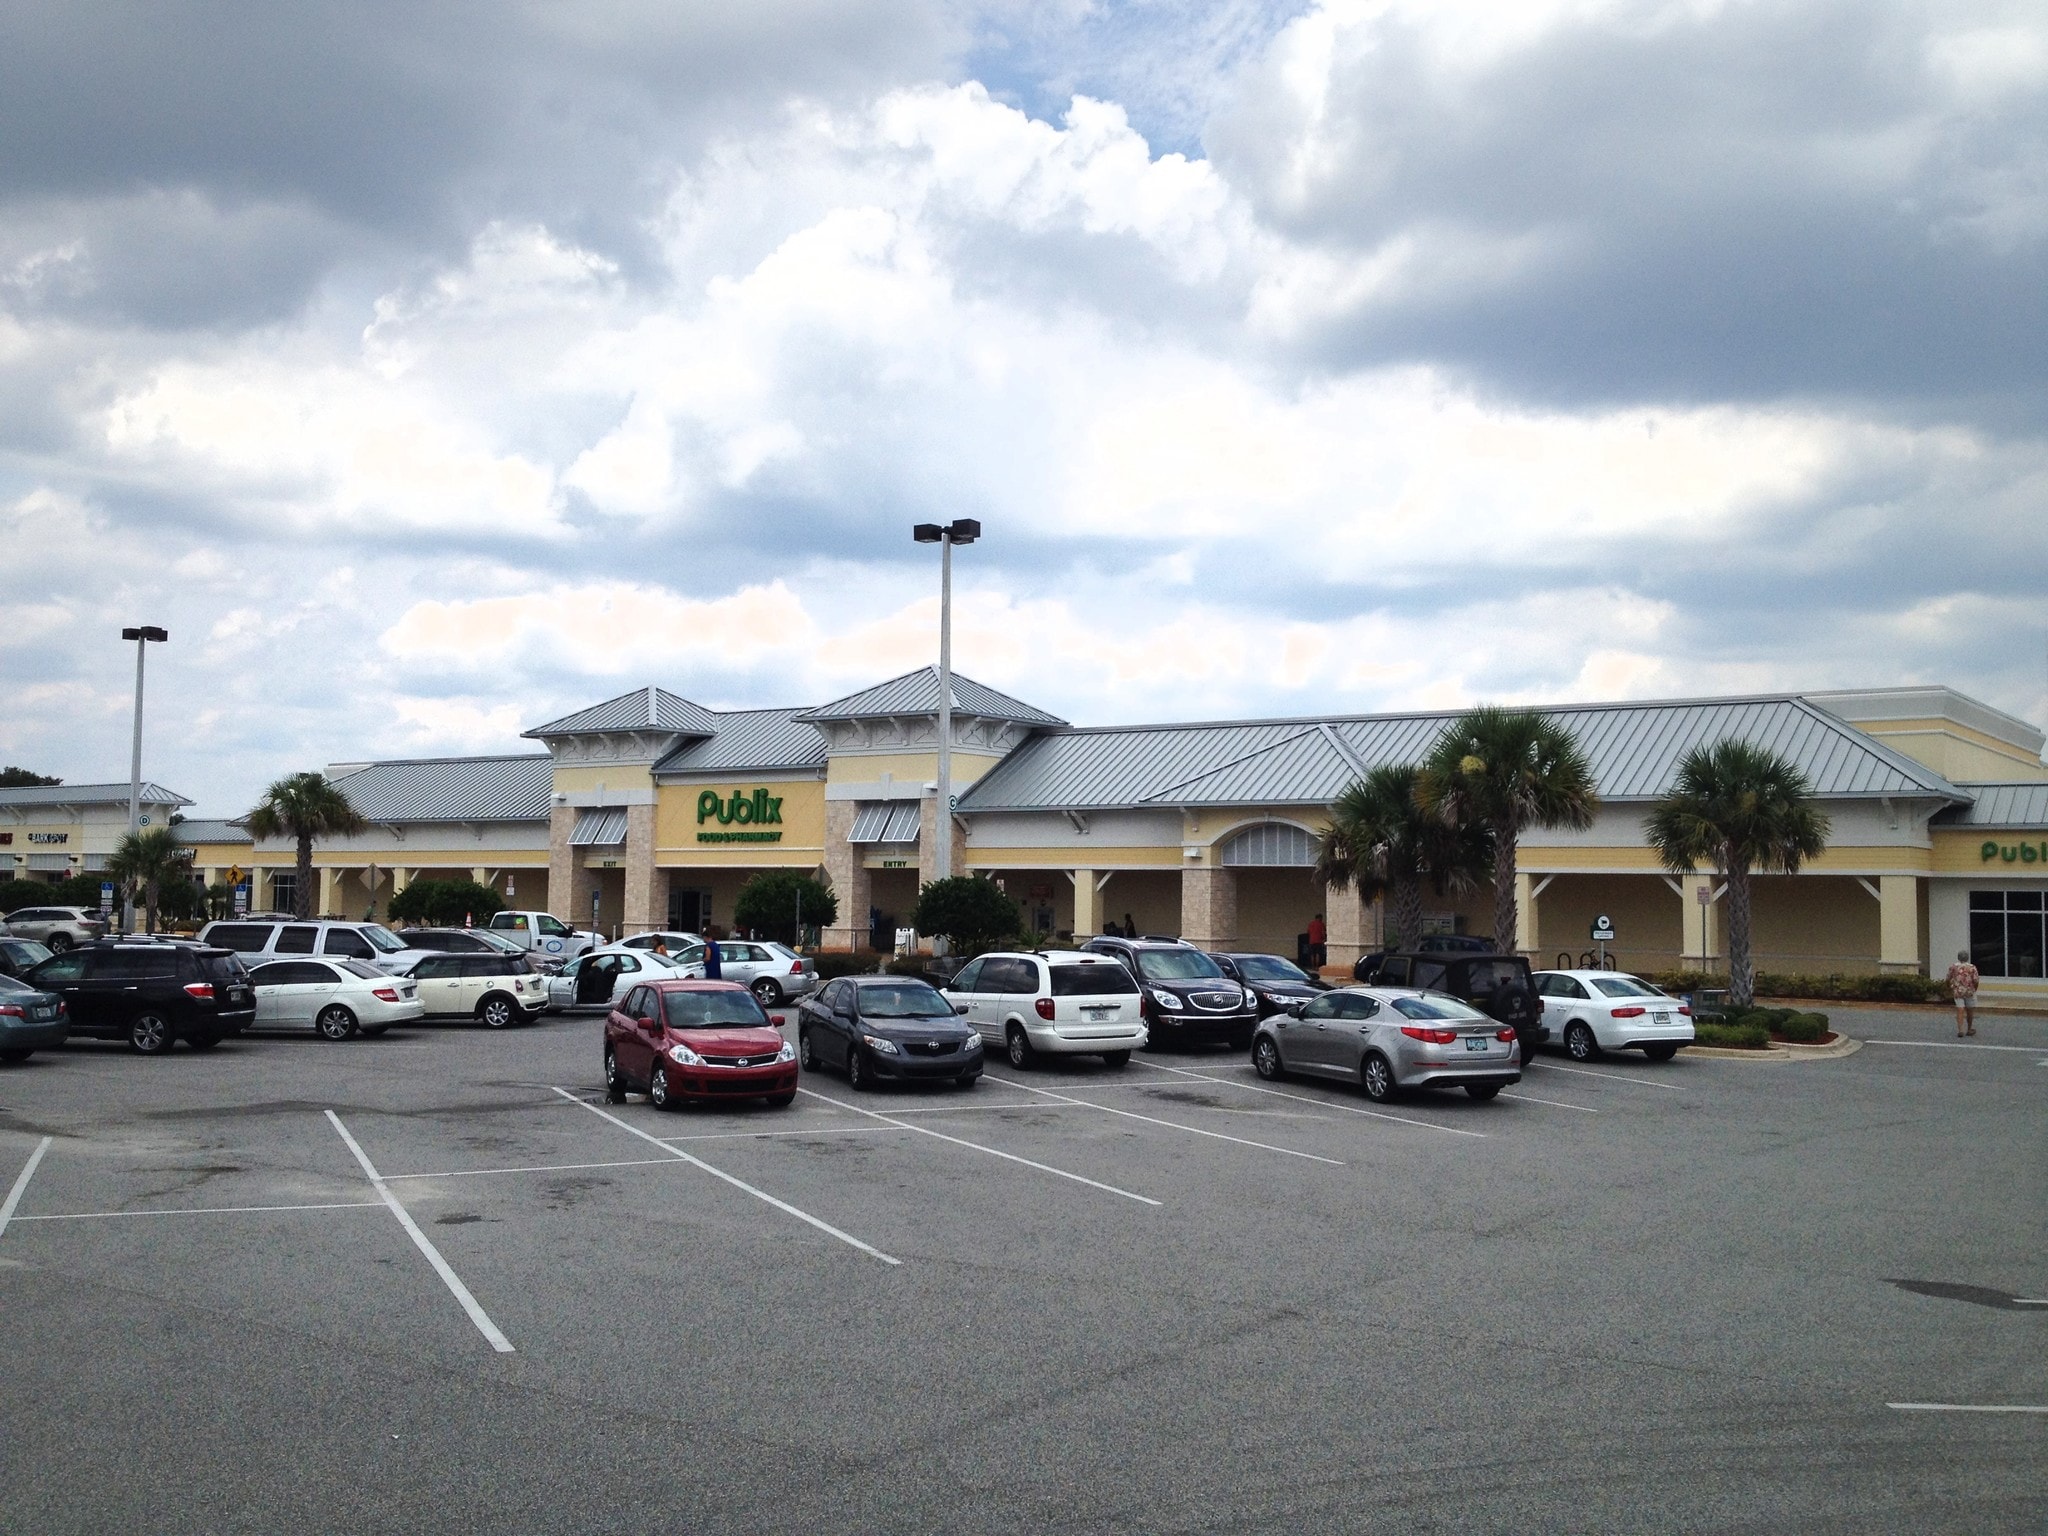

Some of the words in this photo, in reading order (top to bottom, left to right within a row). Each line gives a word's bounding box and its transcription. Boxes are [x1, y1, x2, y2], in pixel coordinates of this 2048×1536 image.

[697, 788, 783, 825] Publix
[697, 832, 722, 842] FOOD
[730, 831, 783, 842] PHARMACY
[883, 860, 907, 868] ENTRY
